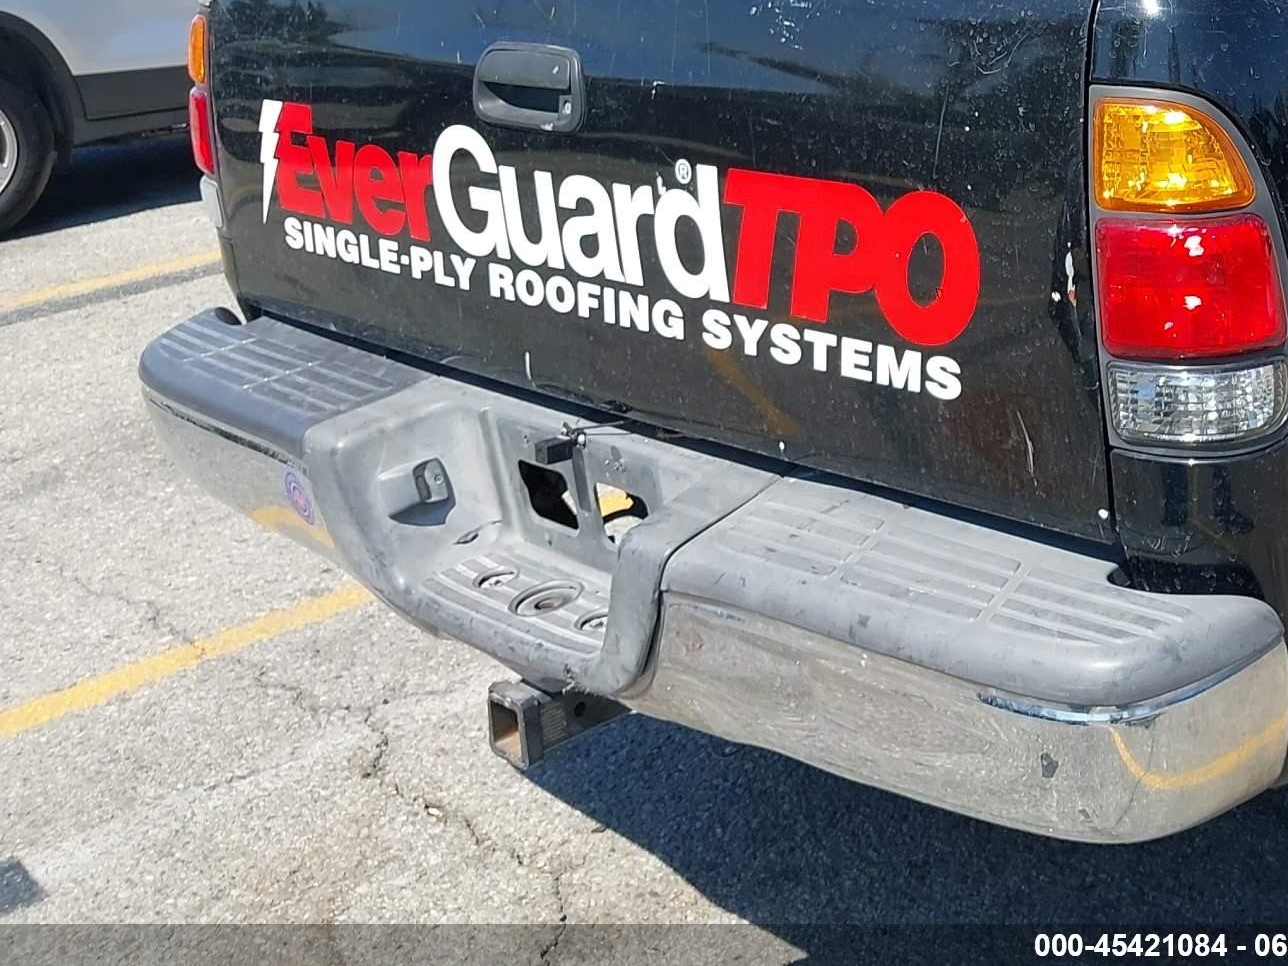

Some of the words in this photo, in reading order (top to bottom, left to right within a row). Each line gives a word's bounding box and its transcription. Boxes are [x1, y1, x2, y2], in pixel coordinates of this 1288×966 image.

[284, 216, 477, 291] SINGLE-PLY
[488, 262, 685, 341] ROOFING
[701, 308, 963, 401] SYSTEMS
